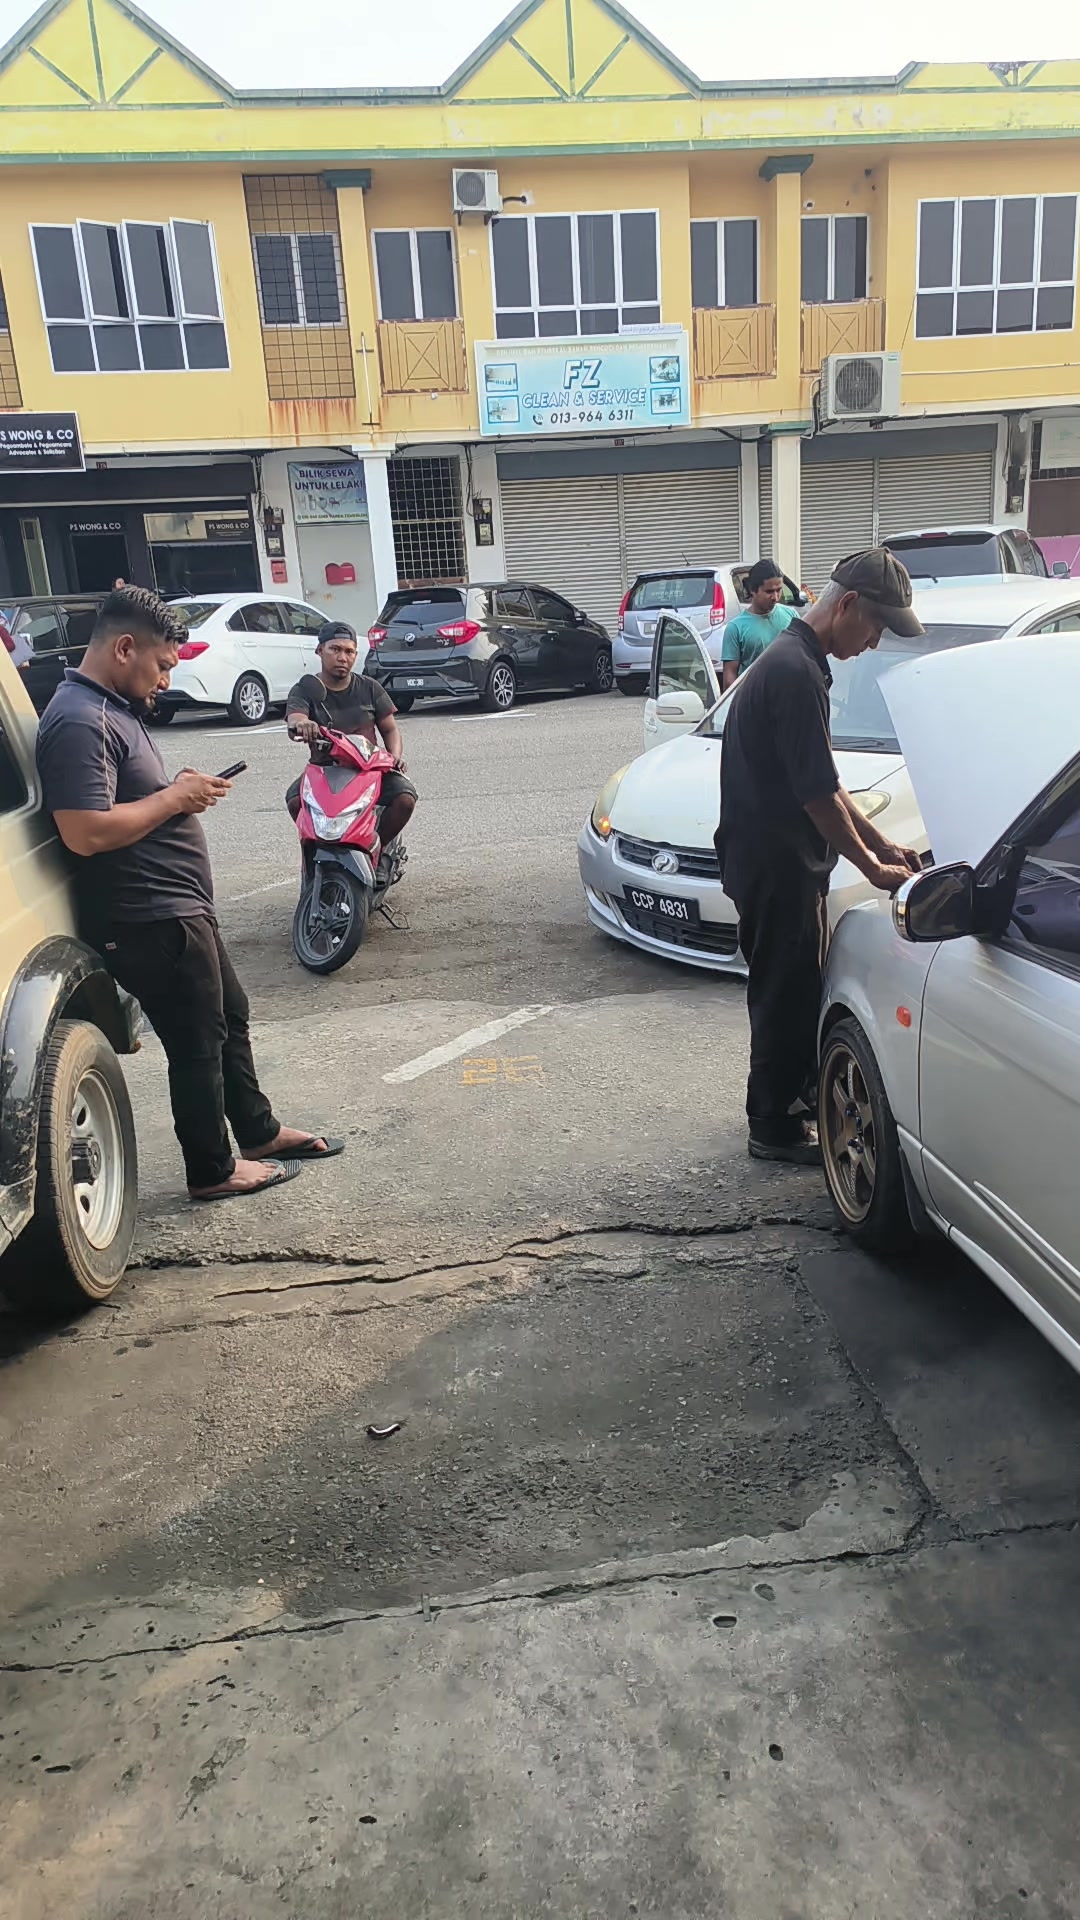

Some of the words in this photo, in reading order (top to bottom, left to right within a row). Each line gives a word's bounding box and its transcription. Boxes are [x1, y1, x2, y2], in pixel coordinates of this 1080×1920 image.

[563, 358, 602, 389] FZ
[522, 391, 570, 408] CLEAN
[573, 390, 584, 406] &
[588, 388, 647, 406] SERVICE
[550, 411, 603, 424] 013-964
[608, 409, 634, 421] 6311
[0, 431, 7, 441] S
[8, 430, 44, 441] WONG
[46, 430, 54, 440] &
[56, 429, 74, 440] CO
[299, 469, 324, 479] BILIK
[325, 468, 355, 478] SEWA
[295, 481, 329, 491] UNTUK
[79, 523, 102, 531] WONG
[109, 522, 121, 530] CO
[631, 891, 655, 910] CCP
[659, 898, 689, 920] 4831
